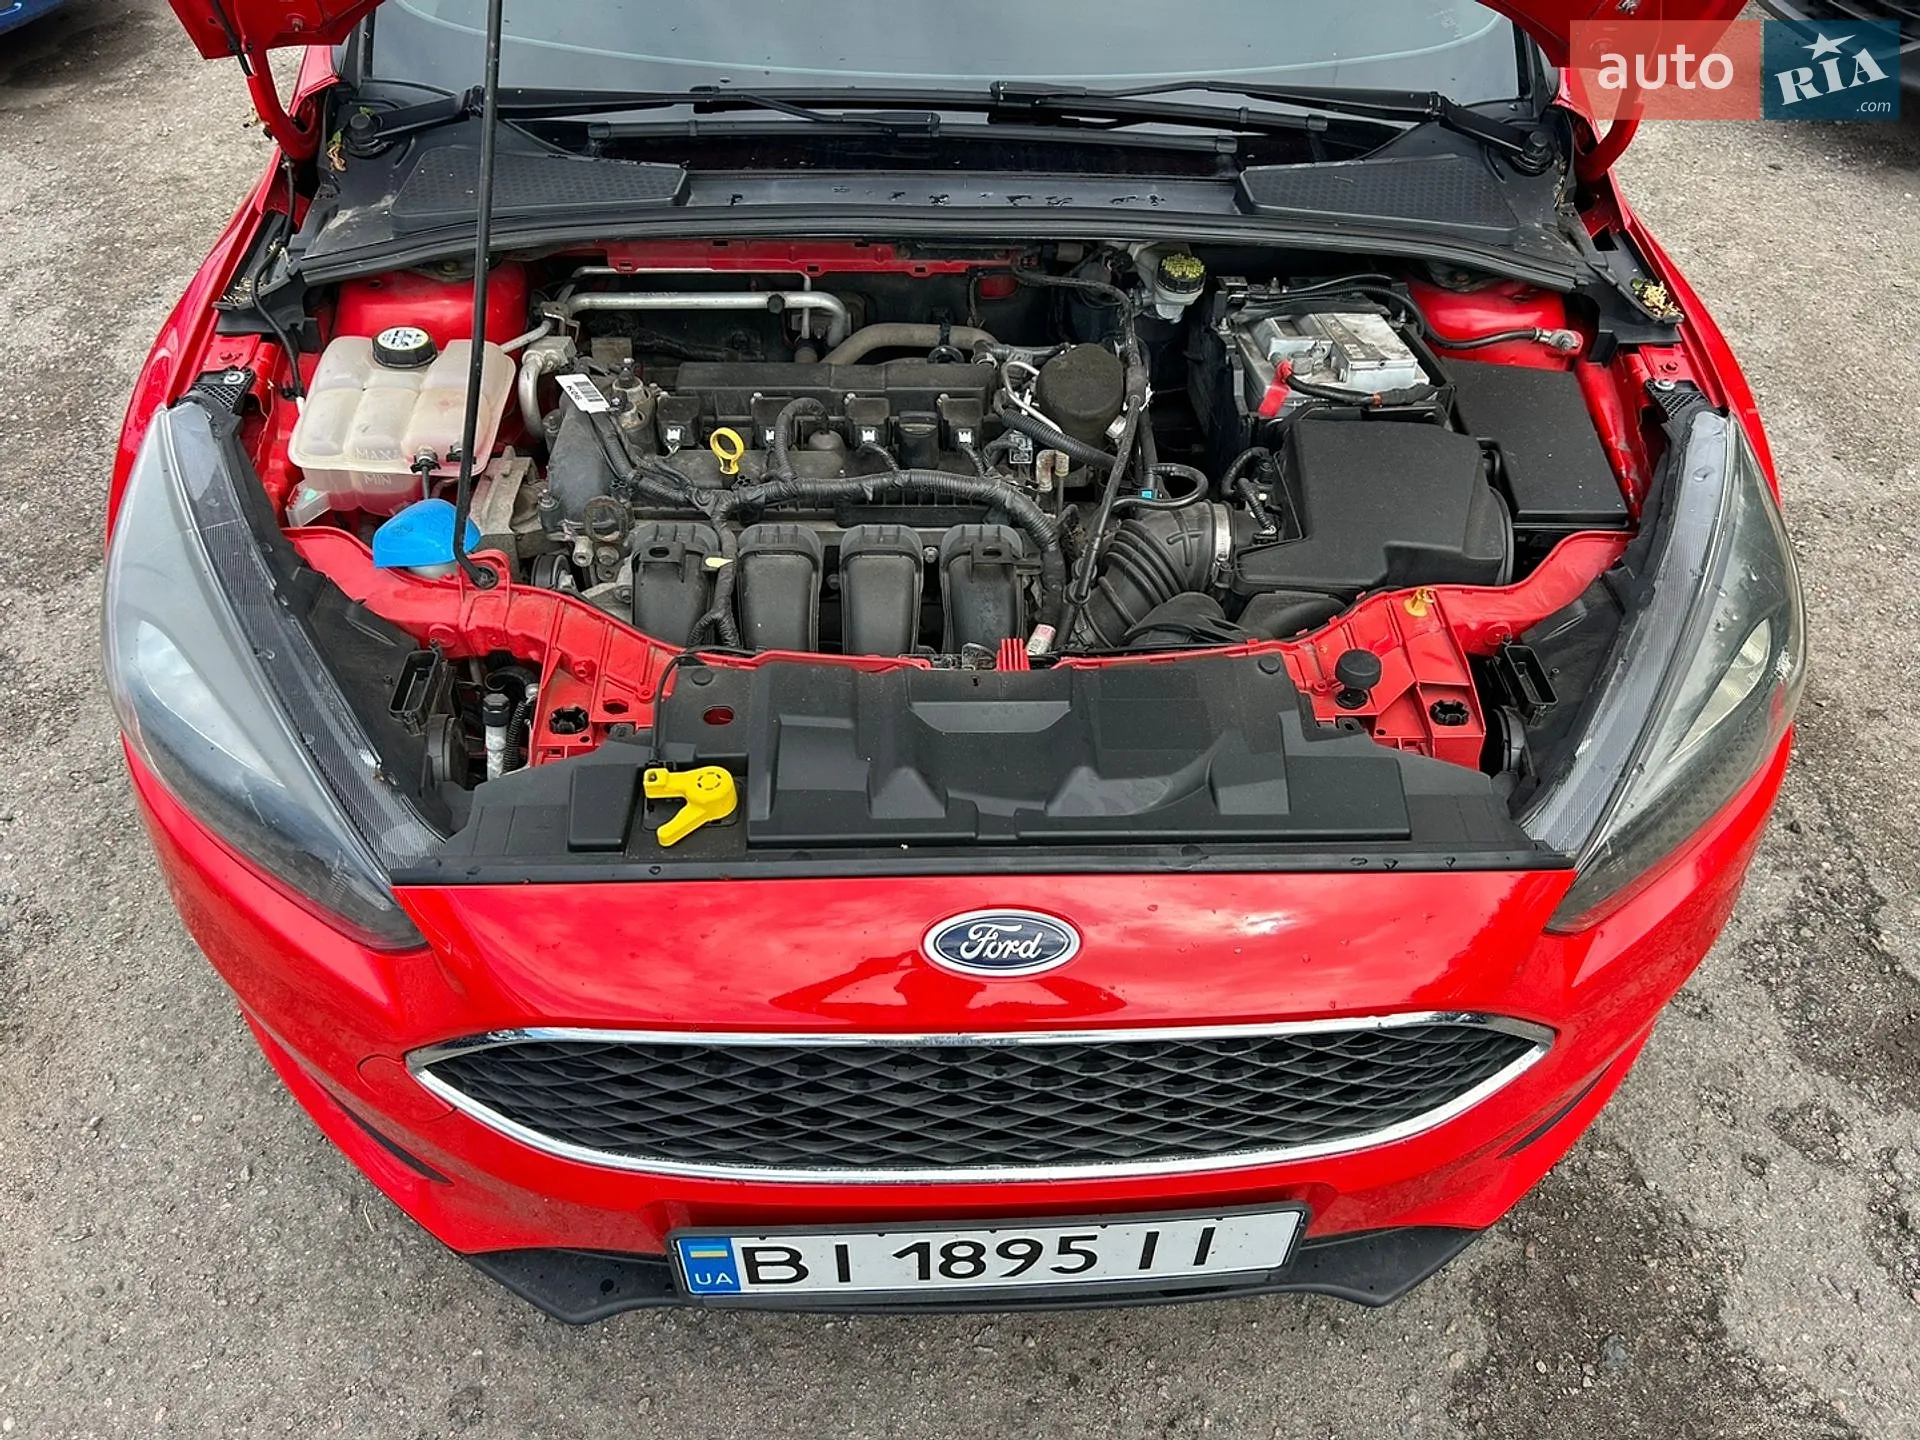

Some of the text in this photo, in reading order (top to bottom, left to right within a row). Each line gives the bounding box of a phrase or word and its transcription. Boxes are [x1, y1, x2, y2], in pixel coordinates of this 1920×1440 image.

[959, 923, 1043, 960] Ford
[891, 1234, 1098, 1282] 1895
[694, 1272, 734, 1285] UA
